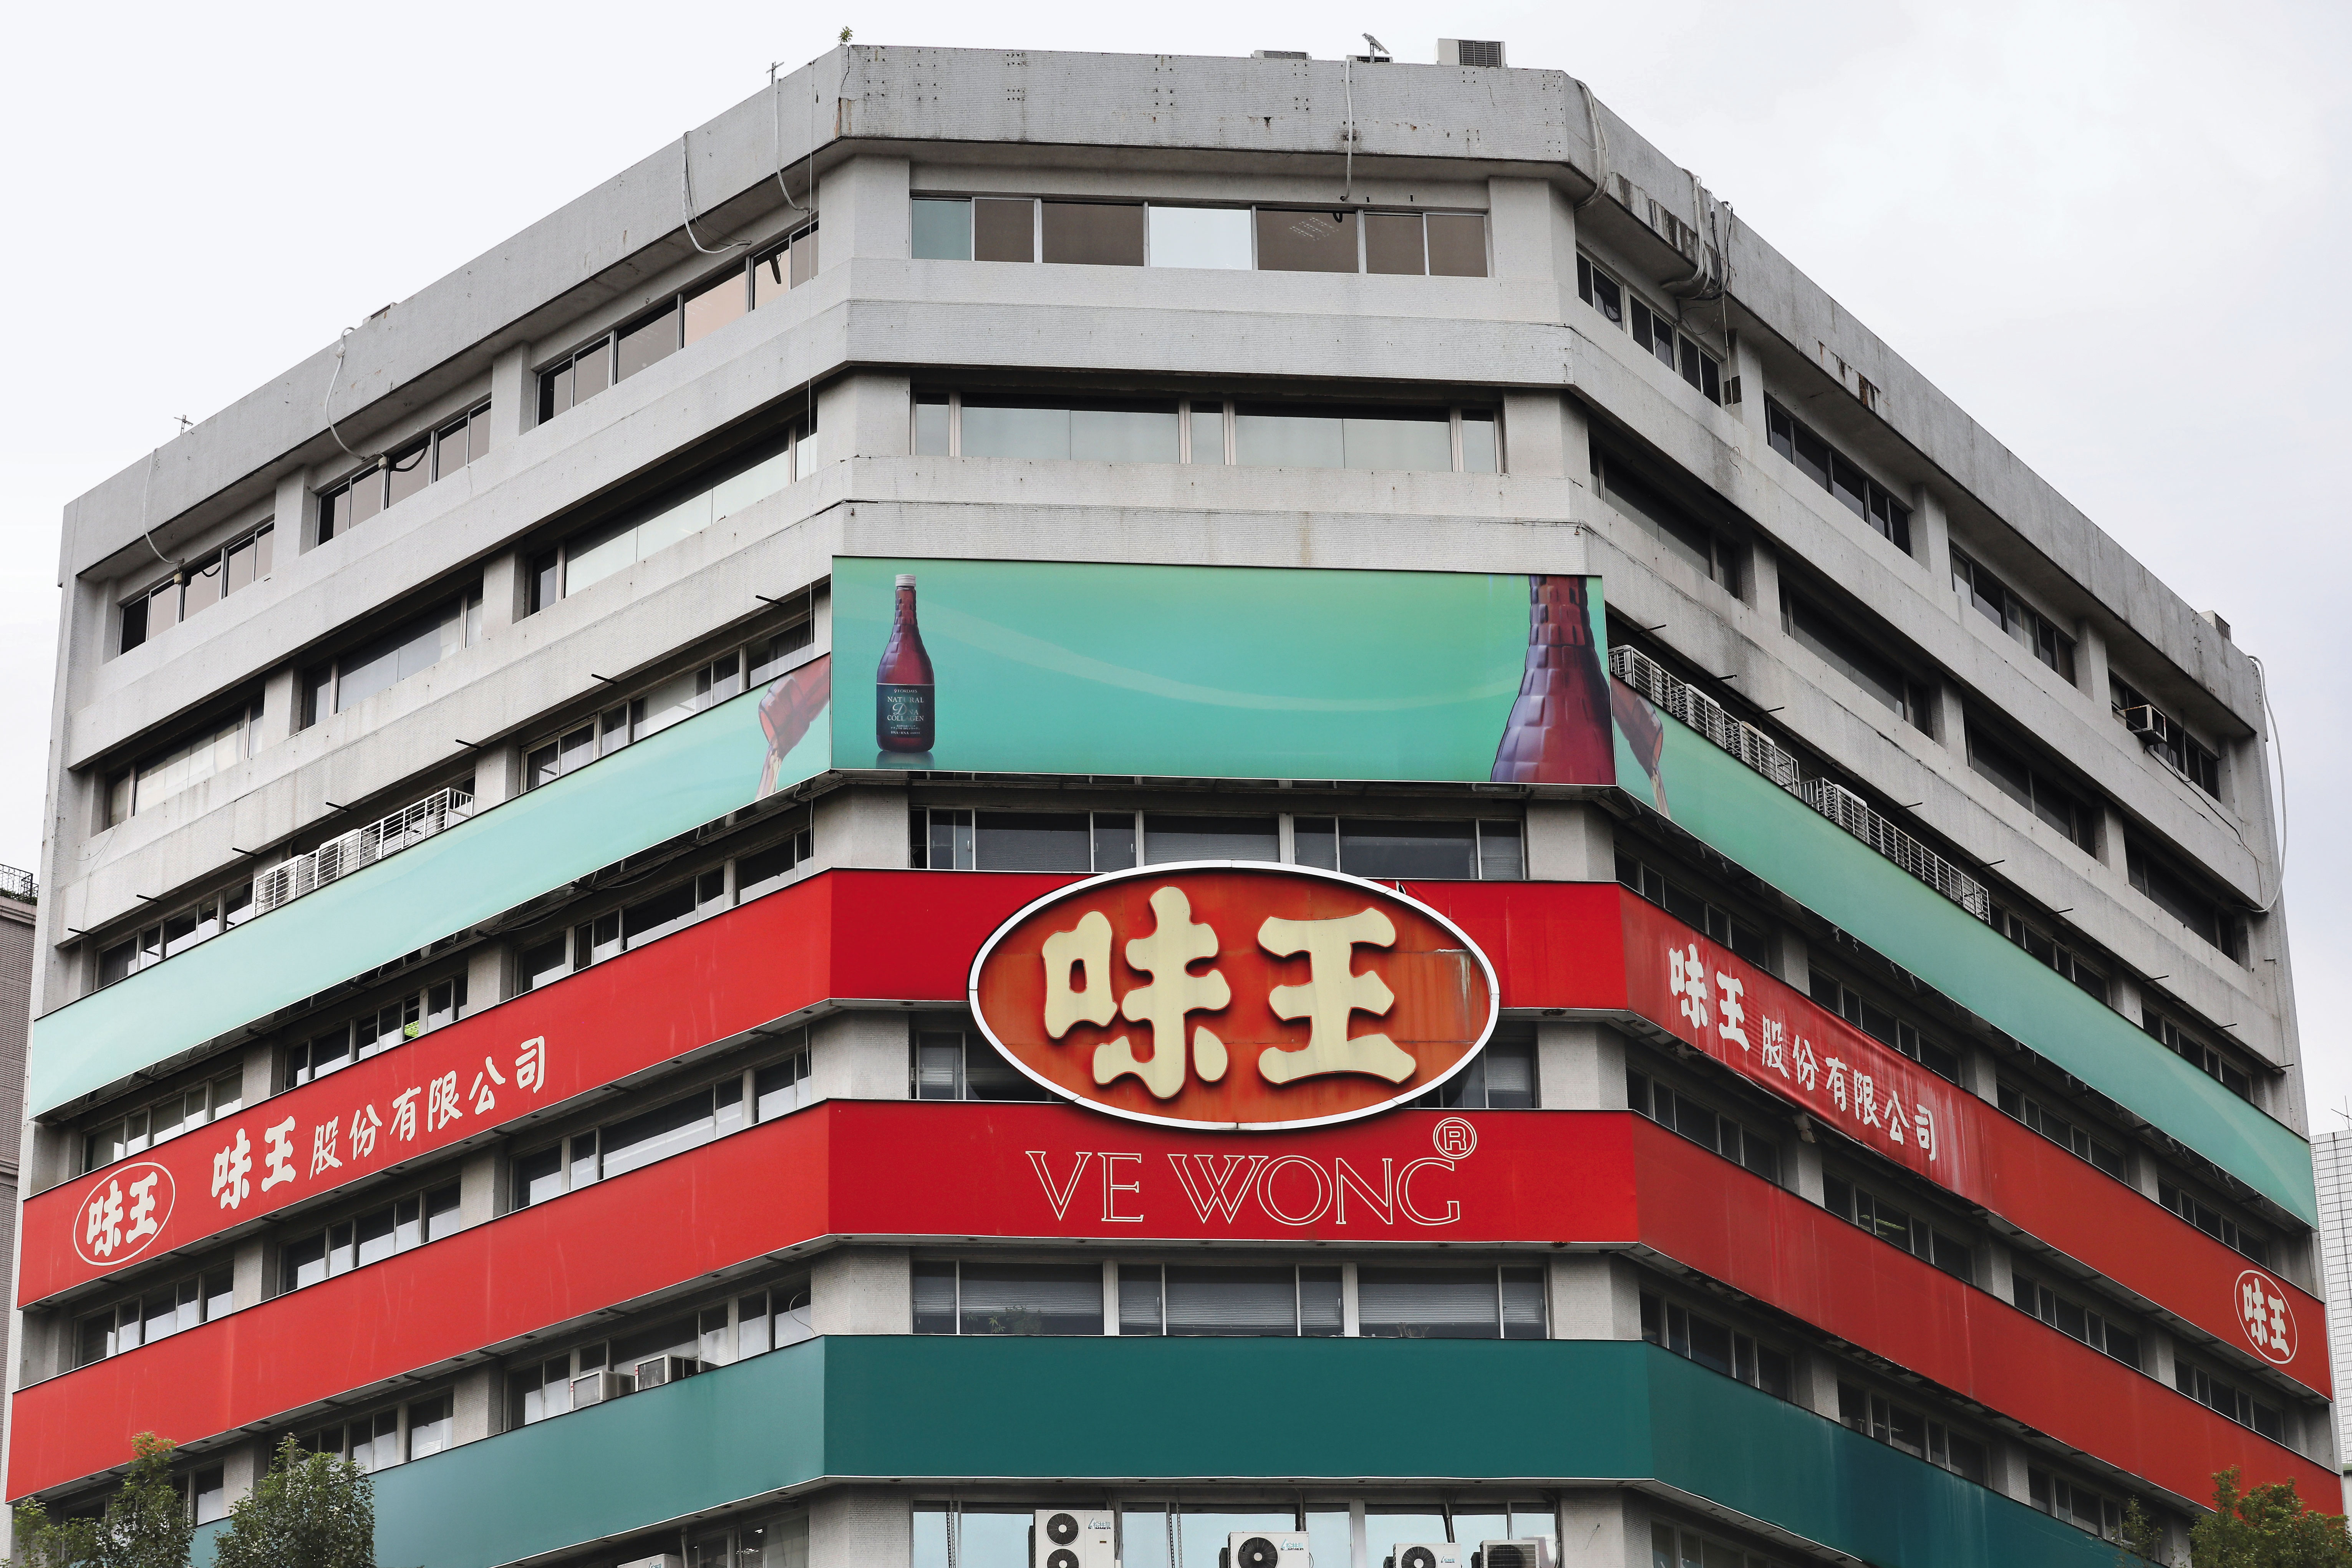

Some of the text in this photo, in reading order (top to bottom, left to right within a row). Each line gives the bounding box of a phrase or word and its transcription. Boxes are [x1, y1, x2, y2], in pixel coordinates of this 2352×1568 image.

[892, 703, 919, 715] DNA
[1042, 886, 1416, 1098] 味王
[1669, 943, 1936, 1162] 味王股份有限公司
[211, 1035, 545, 1210] 味王股份有限公司
[86, 1171, 158, 1257] 味王
[1025, 1150, 1144, 1222] VE
[1167, 1154, 1460, 1226] WONG
[2243, 1278, 2290, 1357] 味王
